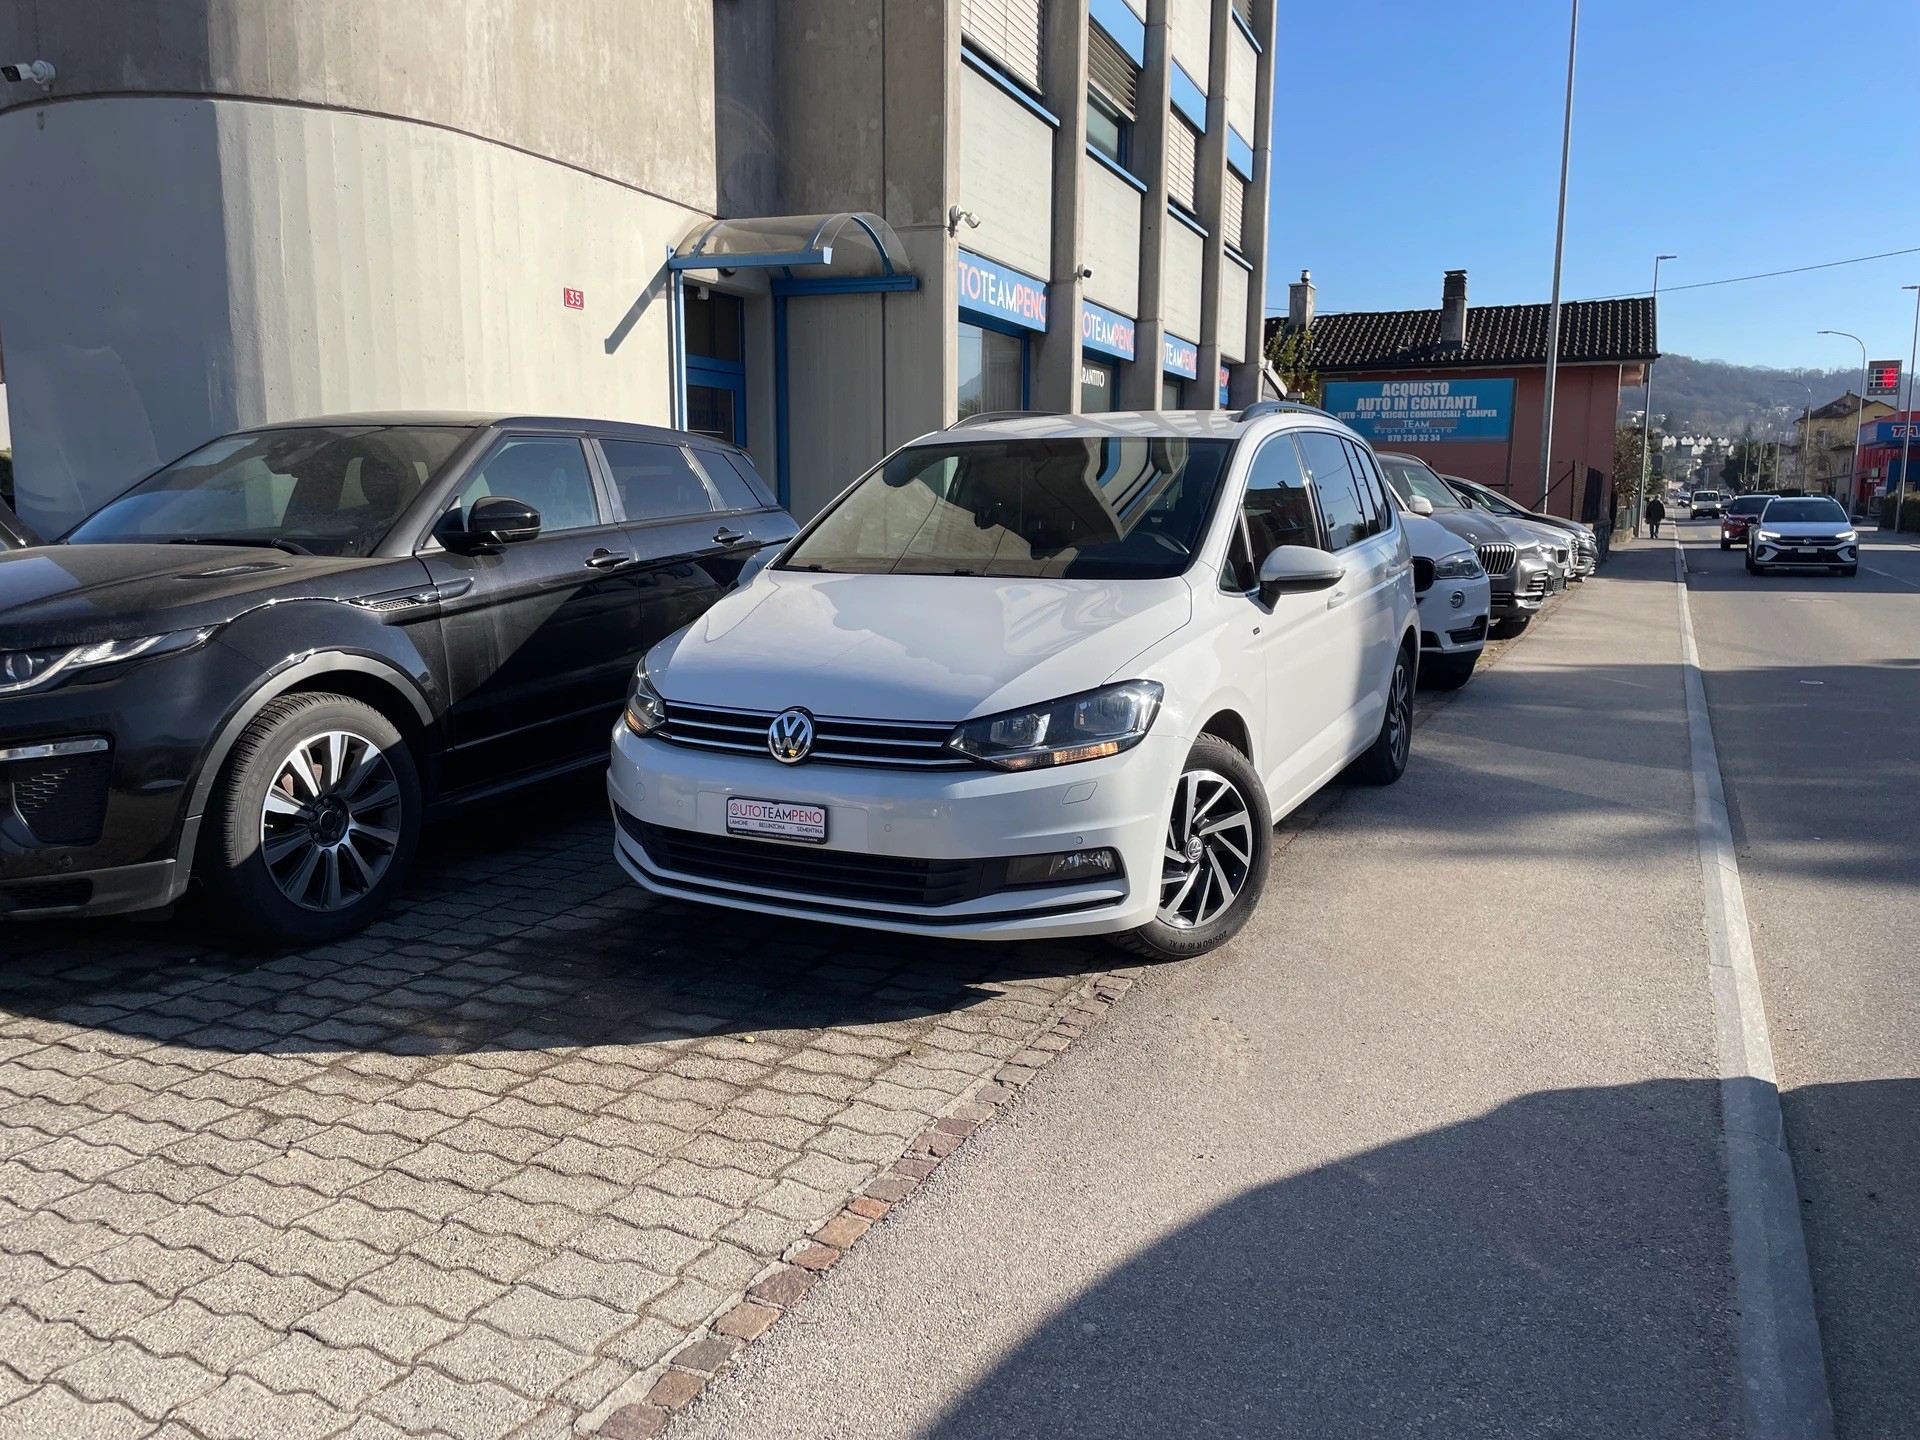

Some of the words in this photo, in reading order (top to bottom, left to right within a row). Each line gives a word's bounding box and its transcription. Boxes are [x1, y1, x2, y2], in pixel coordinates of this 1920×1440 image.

[568, 290, 581, 306] 35
[958, 260, 1047, 324] TOTEAMPENO
[1382, 382, 1450, 397] ACQUISTO
[1356, 397, 1391, 411] AUTO
[1394, 397, 1408, 410] IN
[1410, 396, 1477, 410] CONTANTI
[1337, 411, 1356, 419] AUTO
[1360, 411, 1376, 419] JEEP
[1381, 411, 1409, 419] VEICOLI
[1410, 410, 1460, 418] COMMERCIALI
[1466, 409, 1498, 418] CAMPER
[1891, 425, 1920, 438] TA
[729, 819, 749, 827] LAMONE
[758, 821, 786, 831] BELLINZONA
[796, 826, 824, 835] SEMENTINA
